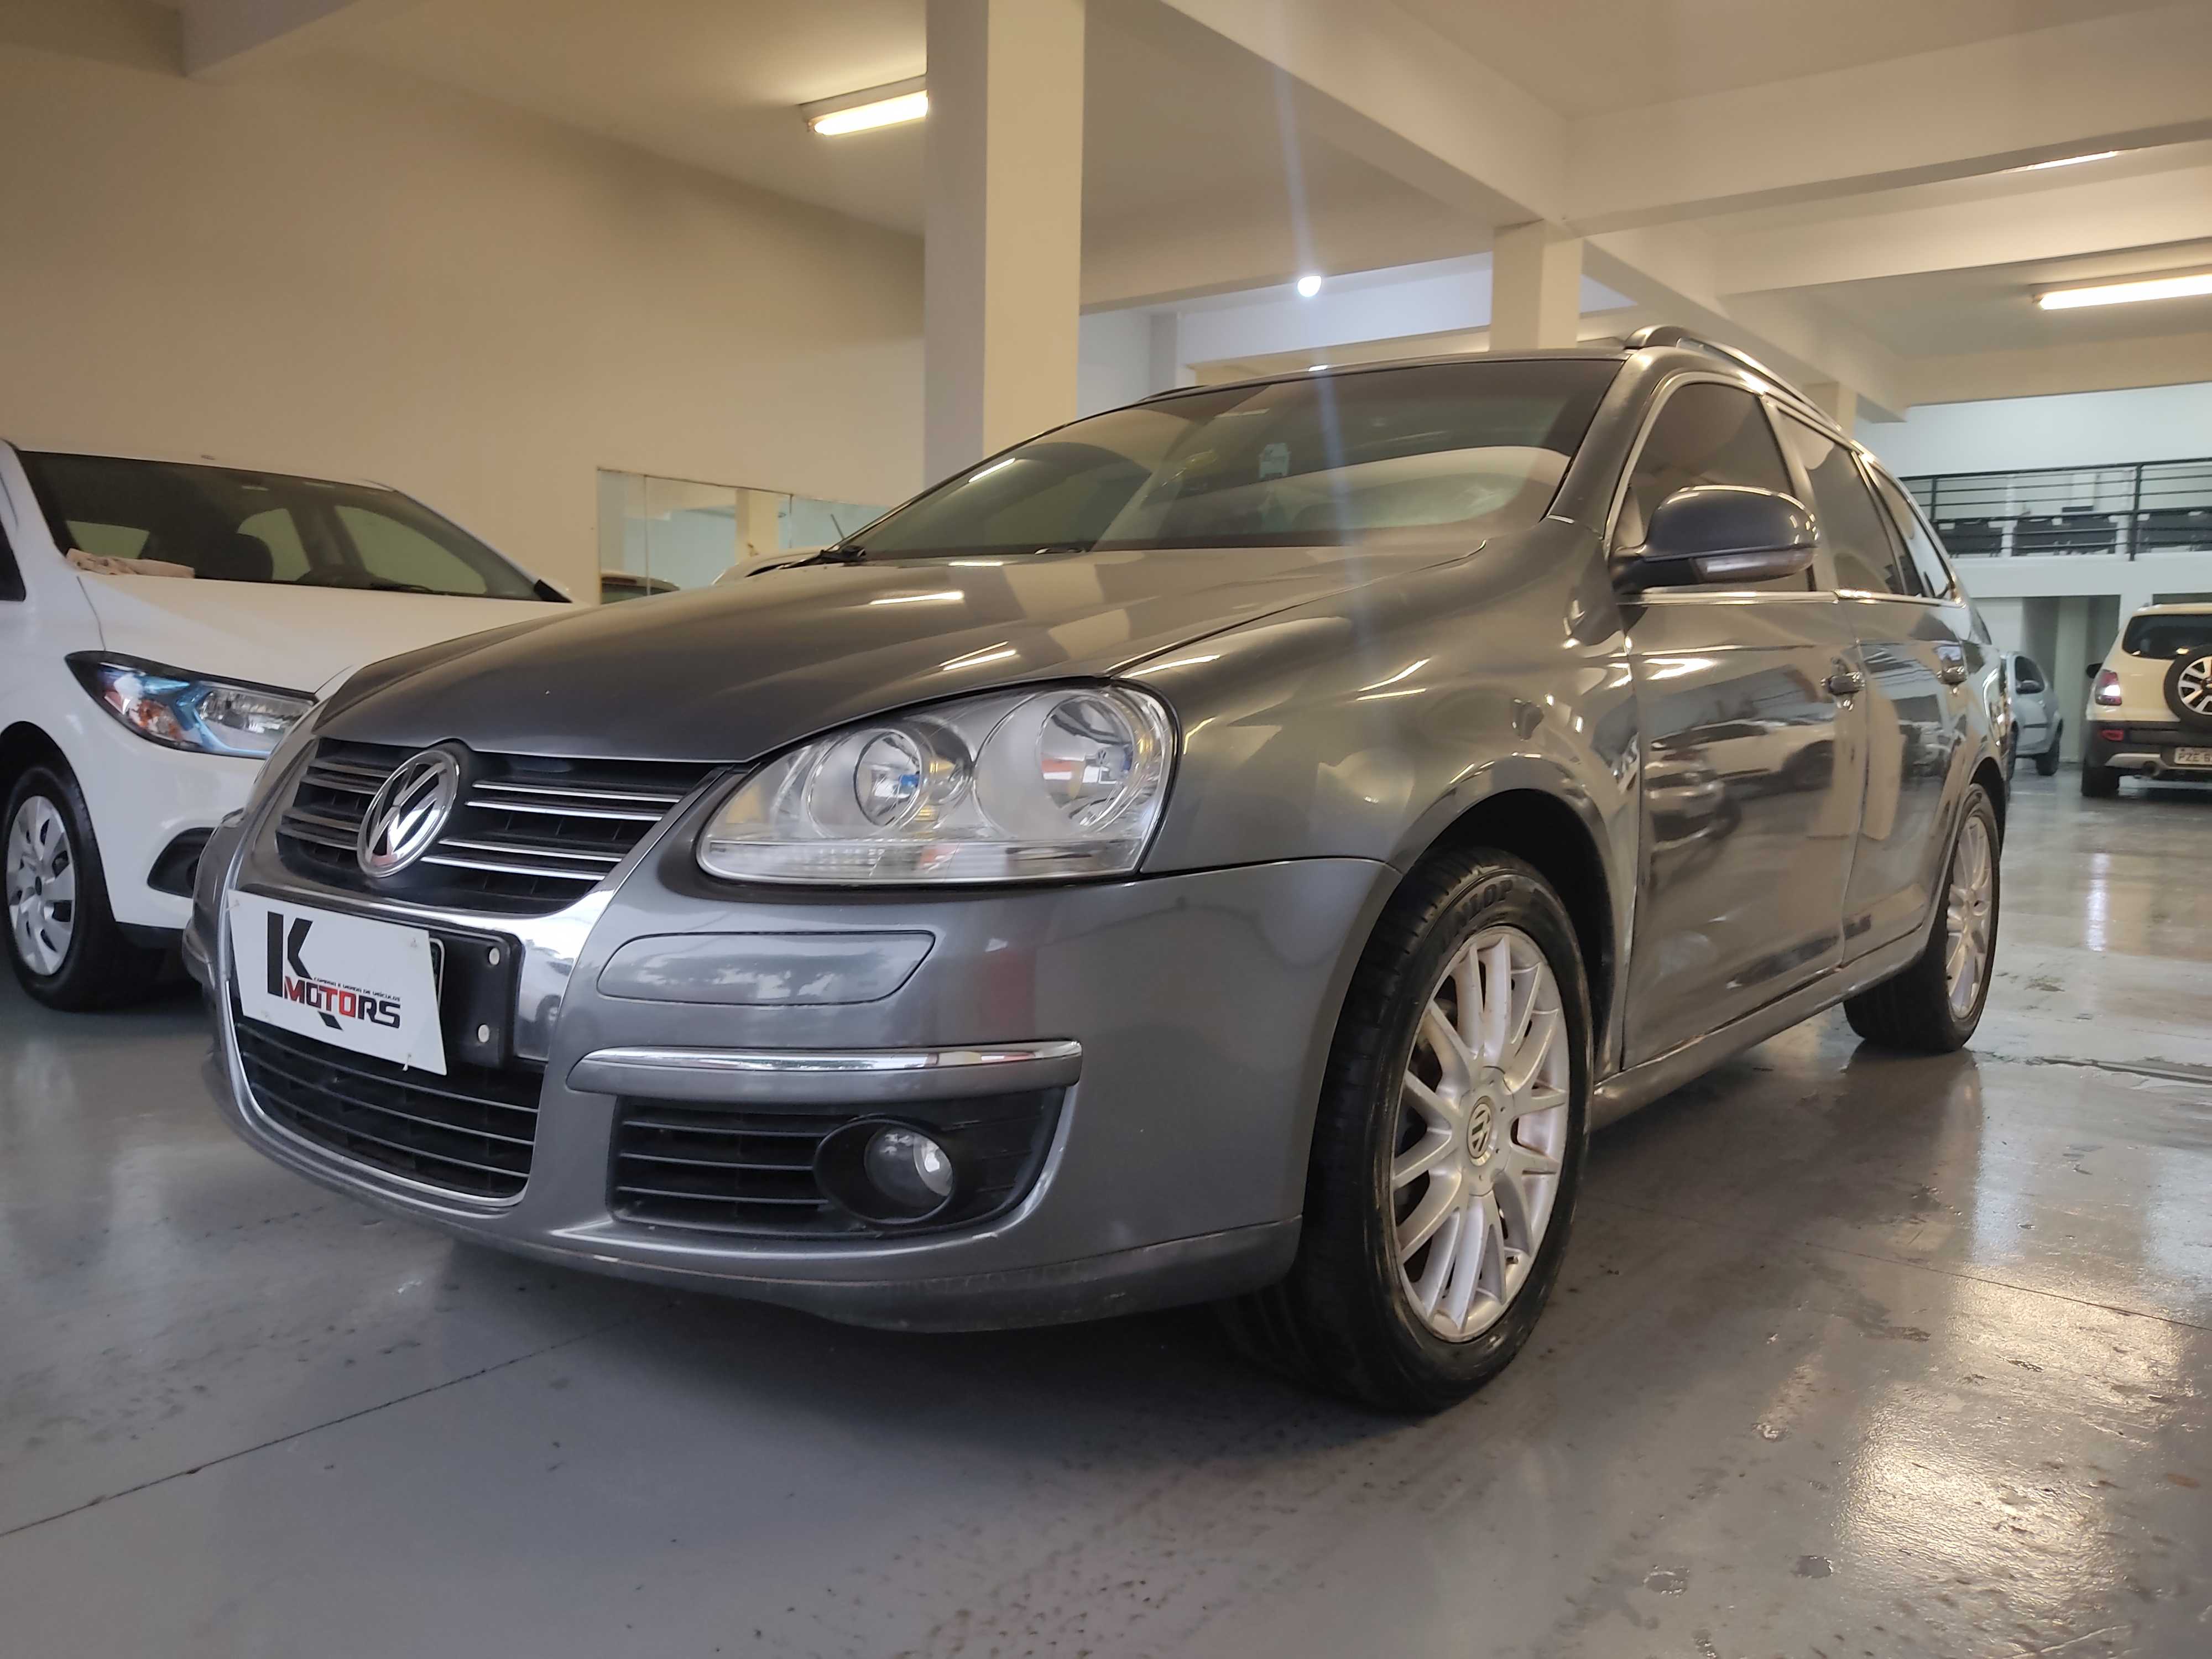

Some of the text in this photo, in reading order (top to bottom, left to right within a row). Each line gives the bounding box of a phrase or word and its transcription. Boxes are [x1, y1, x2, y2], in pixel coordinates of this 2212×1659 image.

[360, 754, 456, 871] VW
[268, 911, 314, 998] K
[284, 976, 400, 1029] MOTORS
